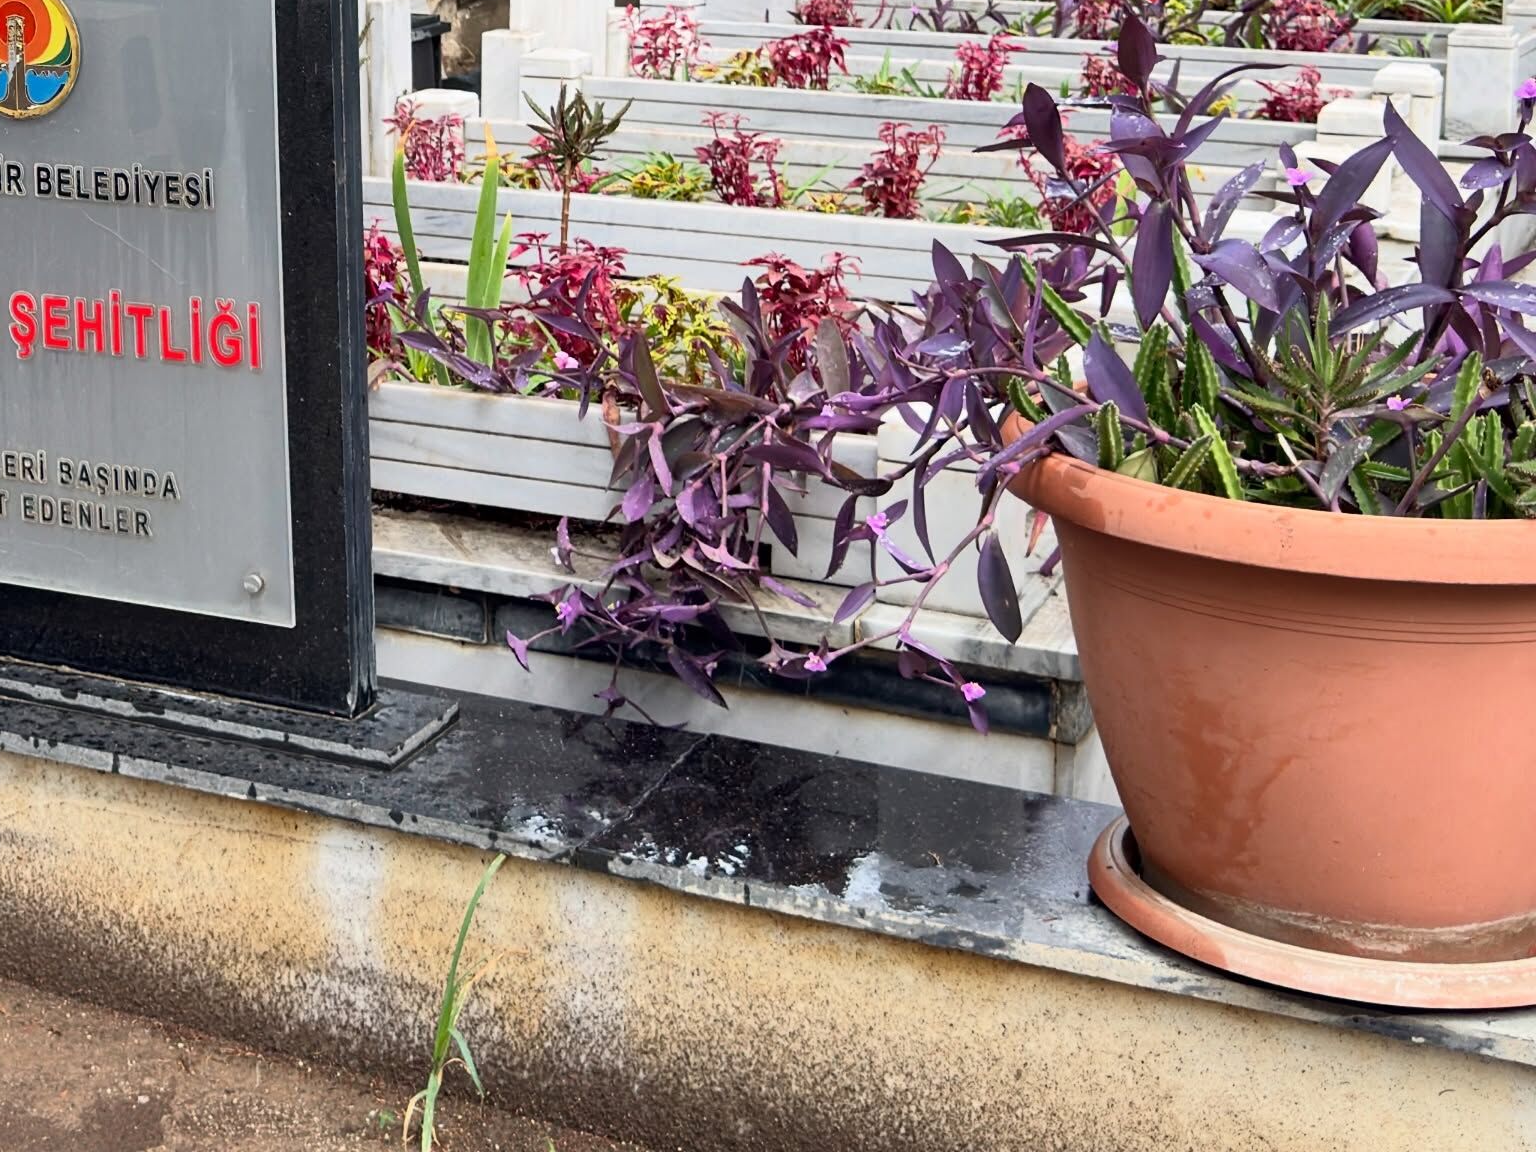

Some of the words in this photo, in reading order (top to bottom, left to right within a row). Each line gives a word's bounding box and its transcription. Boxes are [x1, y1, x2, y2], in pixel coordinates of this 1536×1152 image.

[35, 164, 213, 208] BELEDİYESİ
[10, 289, 261, 369] ŞEHİTLİĞİ
[58, 458, 180, 499] BAŞINDA
[22, 494, 152, 535] EDENLER
